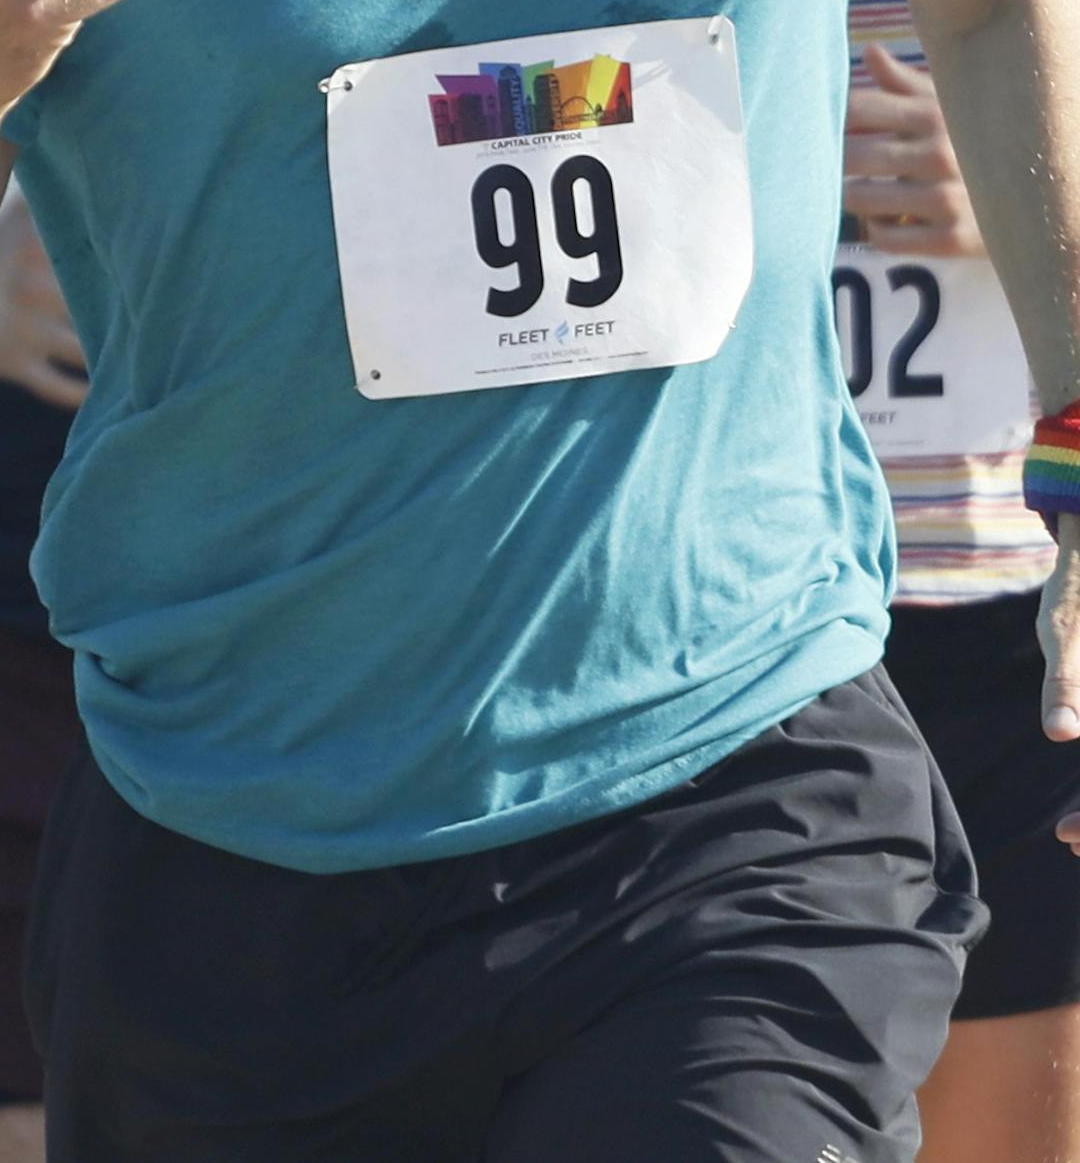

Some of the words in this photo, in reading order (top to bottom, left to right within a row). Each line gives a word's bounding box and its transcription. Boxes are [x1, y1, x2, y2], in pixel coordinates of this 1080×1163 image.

[491, 136, 530, 150] CAPITAL
[532, 134, 553, 146] CITY
[555, 132, 583, 142] PRIDE
[470, 154, 624, 318] 99
[498, 328, 550, 347] FLEET
[574, 320, 616, 337] FEET
